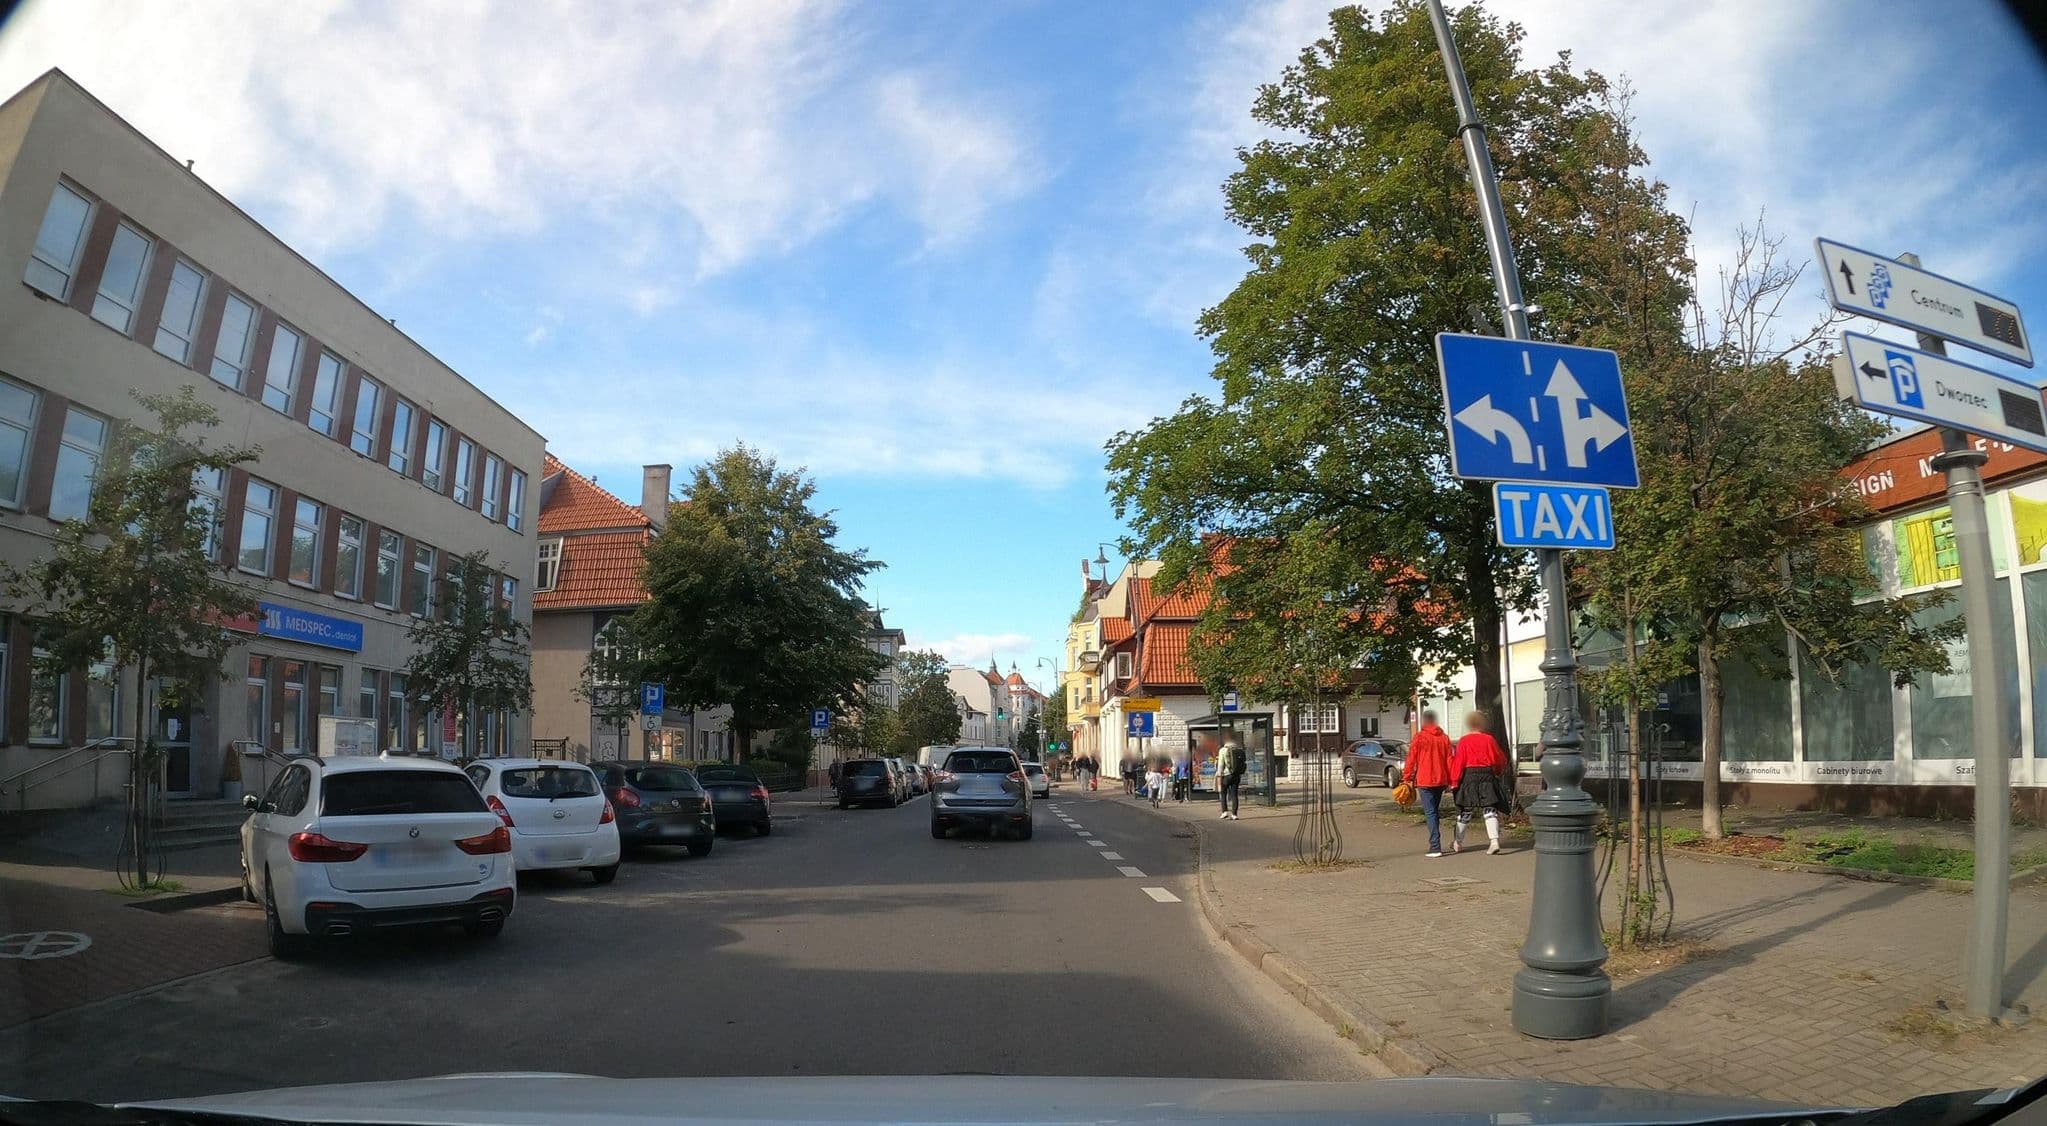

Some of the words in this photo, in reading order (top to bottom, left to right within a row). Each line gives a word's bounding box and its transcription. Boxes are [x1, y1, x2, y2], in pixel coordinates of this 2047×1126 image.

[1911, 289, 1965, 319] Centrum
[1935, 381, 1988, 409] Dworzec
[1500, 490, 1608, 541] TAXI
[285, 615, 331, 638] MEDSPEC
[815, 711, 826, 726] P
[1751, 766, 1781, 774] monolitu
[1816, 766, 1849, 776] Gabinety
[1851, 766, 1883, 775] biurowe
[1956, 765, 1976, 776] Szaf
